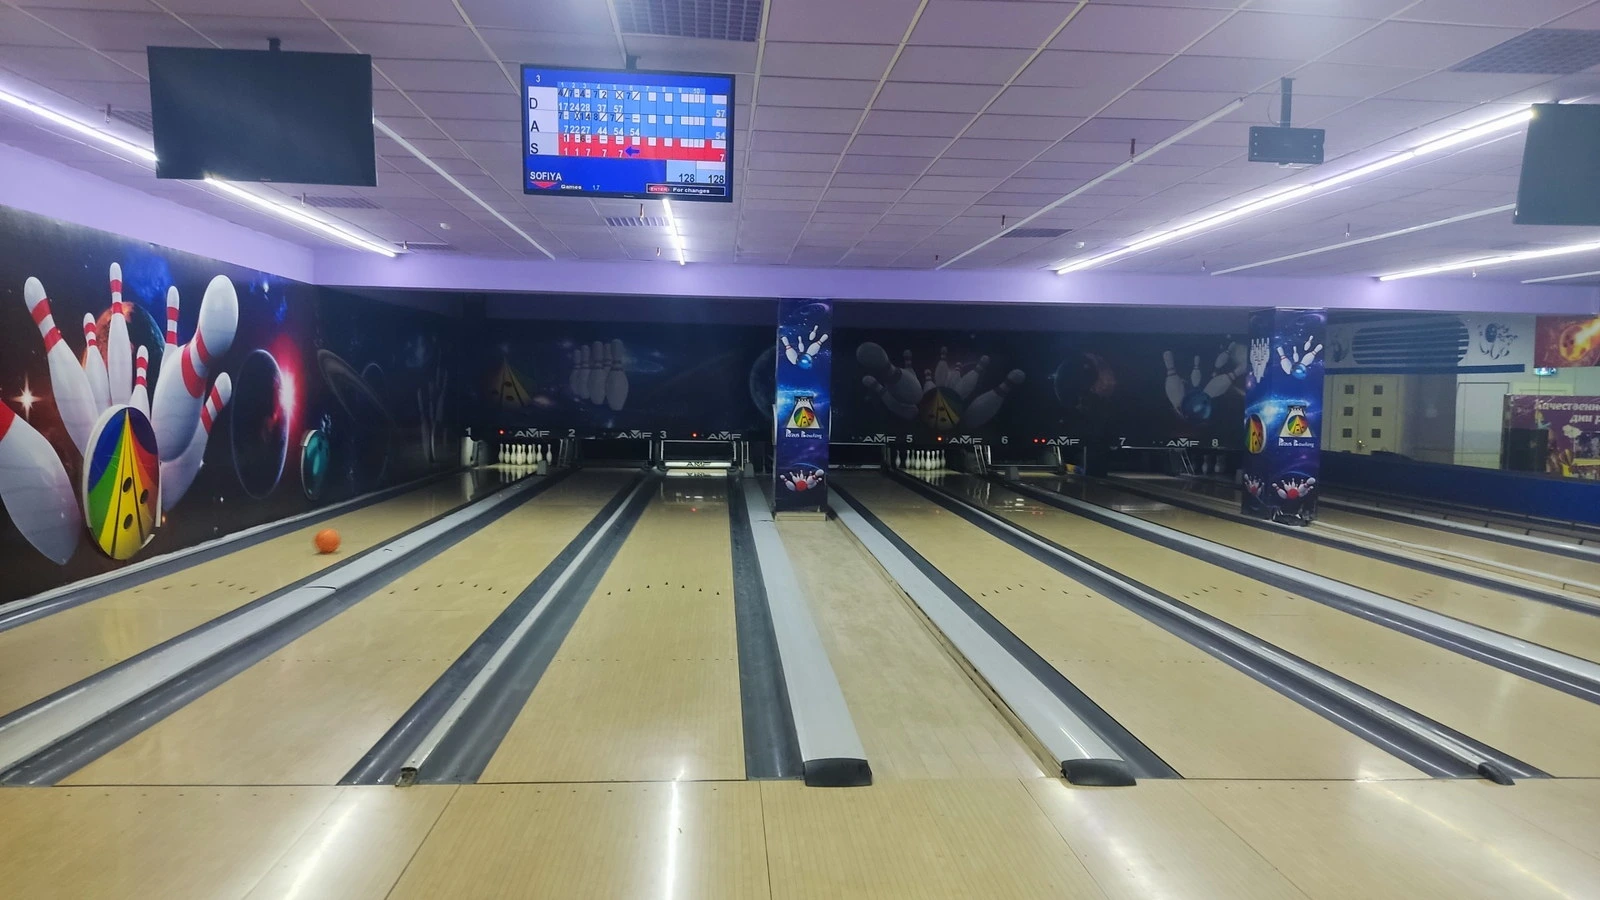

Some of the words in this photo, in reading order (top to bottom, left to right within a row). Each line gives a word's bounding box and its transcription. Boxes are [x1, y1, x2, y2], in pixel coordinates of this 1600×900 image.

[536, 74, 540, 82] 3
[530, 98, 538, 109] D
[531, 120, 540, 132] A
[530, 143, 539, 154] S
[530, 171, 562, 181] SOFIYA
[679, 173, 695, 182] 128
[708, 175, 724, 183] 128
[514, 428, 550, 438] AMF
[568, 429, 576, 437] 2
[617, 430, 652, 439] AMF
[660, 430, 667, 439] 3
[707, 431, 741, 440] AMF
[862, 434, 896, 443] AMF
[906, 435, 913, 443] 5
[949, 435, 983, 444] AMF
[1001, 436, 1008, 444] 6
[1046, 436, 1080, 446] AMF
[1166, 438, 1200, 447] AMF
[1211, 439, 1219, 447] 8
